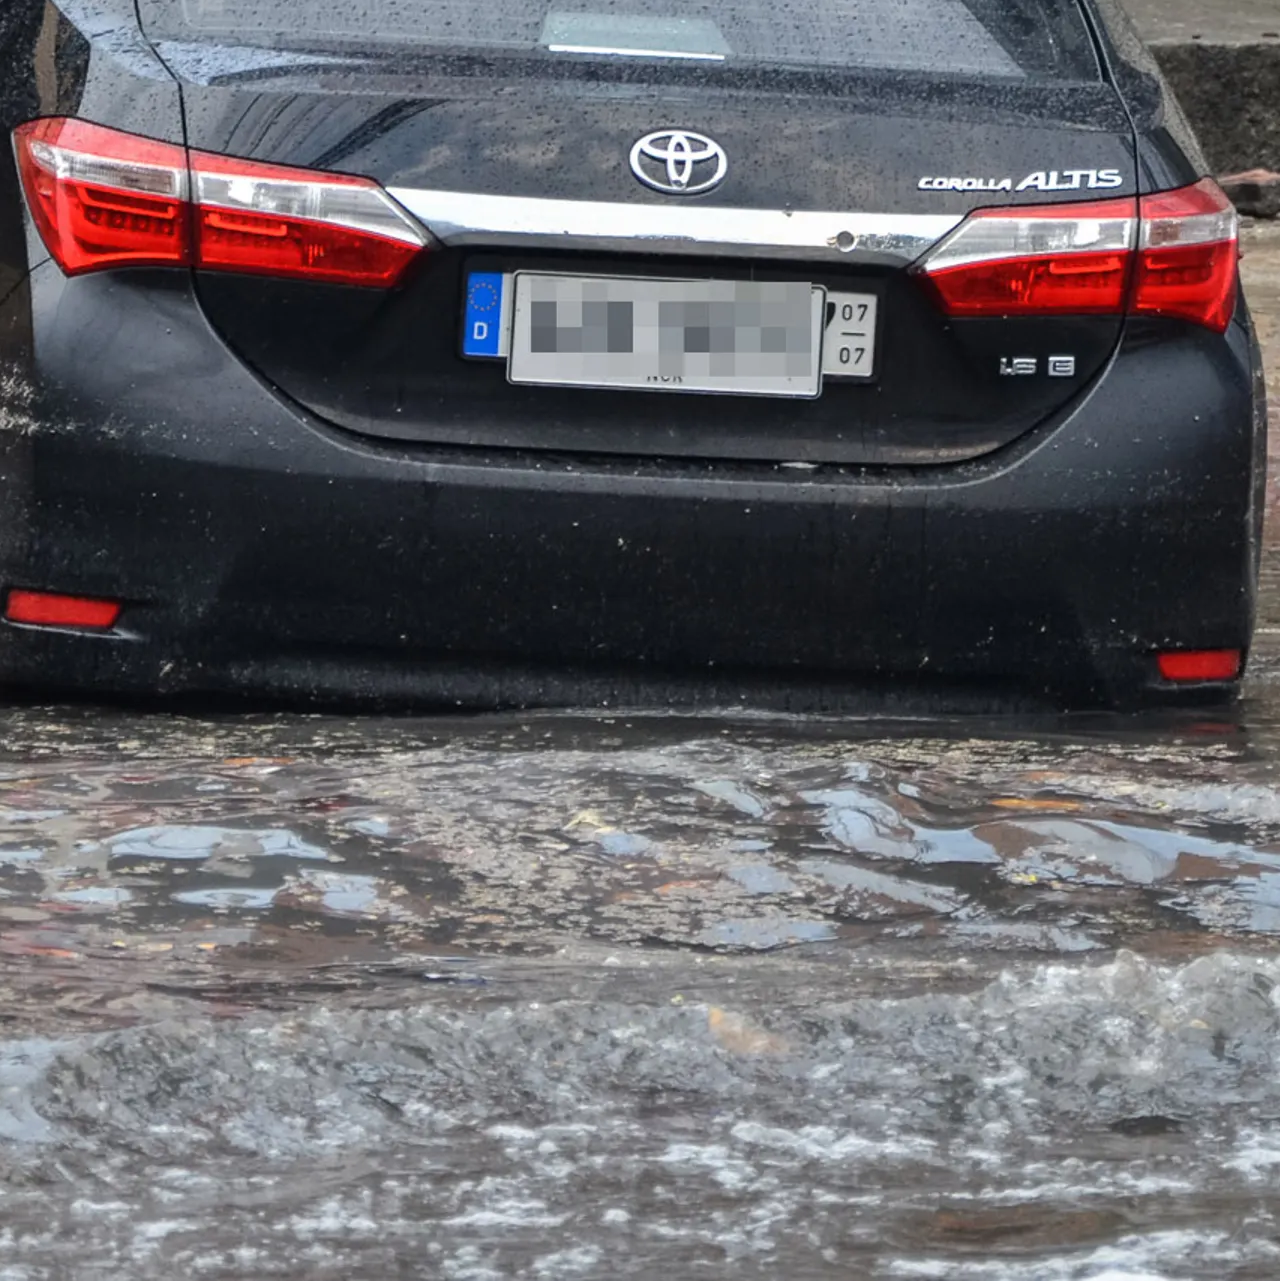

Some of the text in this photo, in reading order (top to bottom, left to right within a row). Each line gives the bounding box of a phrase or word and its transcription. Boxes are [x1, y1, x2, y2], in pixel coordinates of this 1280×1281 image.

[917, 169, 1123, 191] COROLLA ALTIS
[842, 304, 868, 321] 07
[473, 321, 488, 340] D
[839, 346, 865, 365] 07
